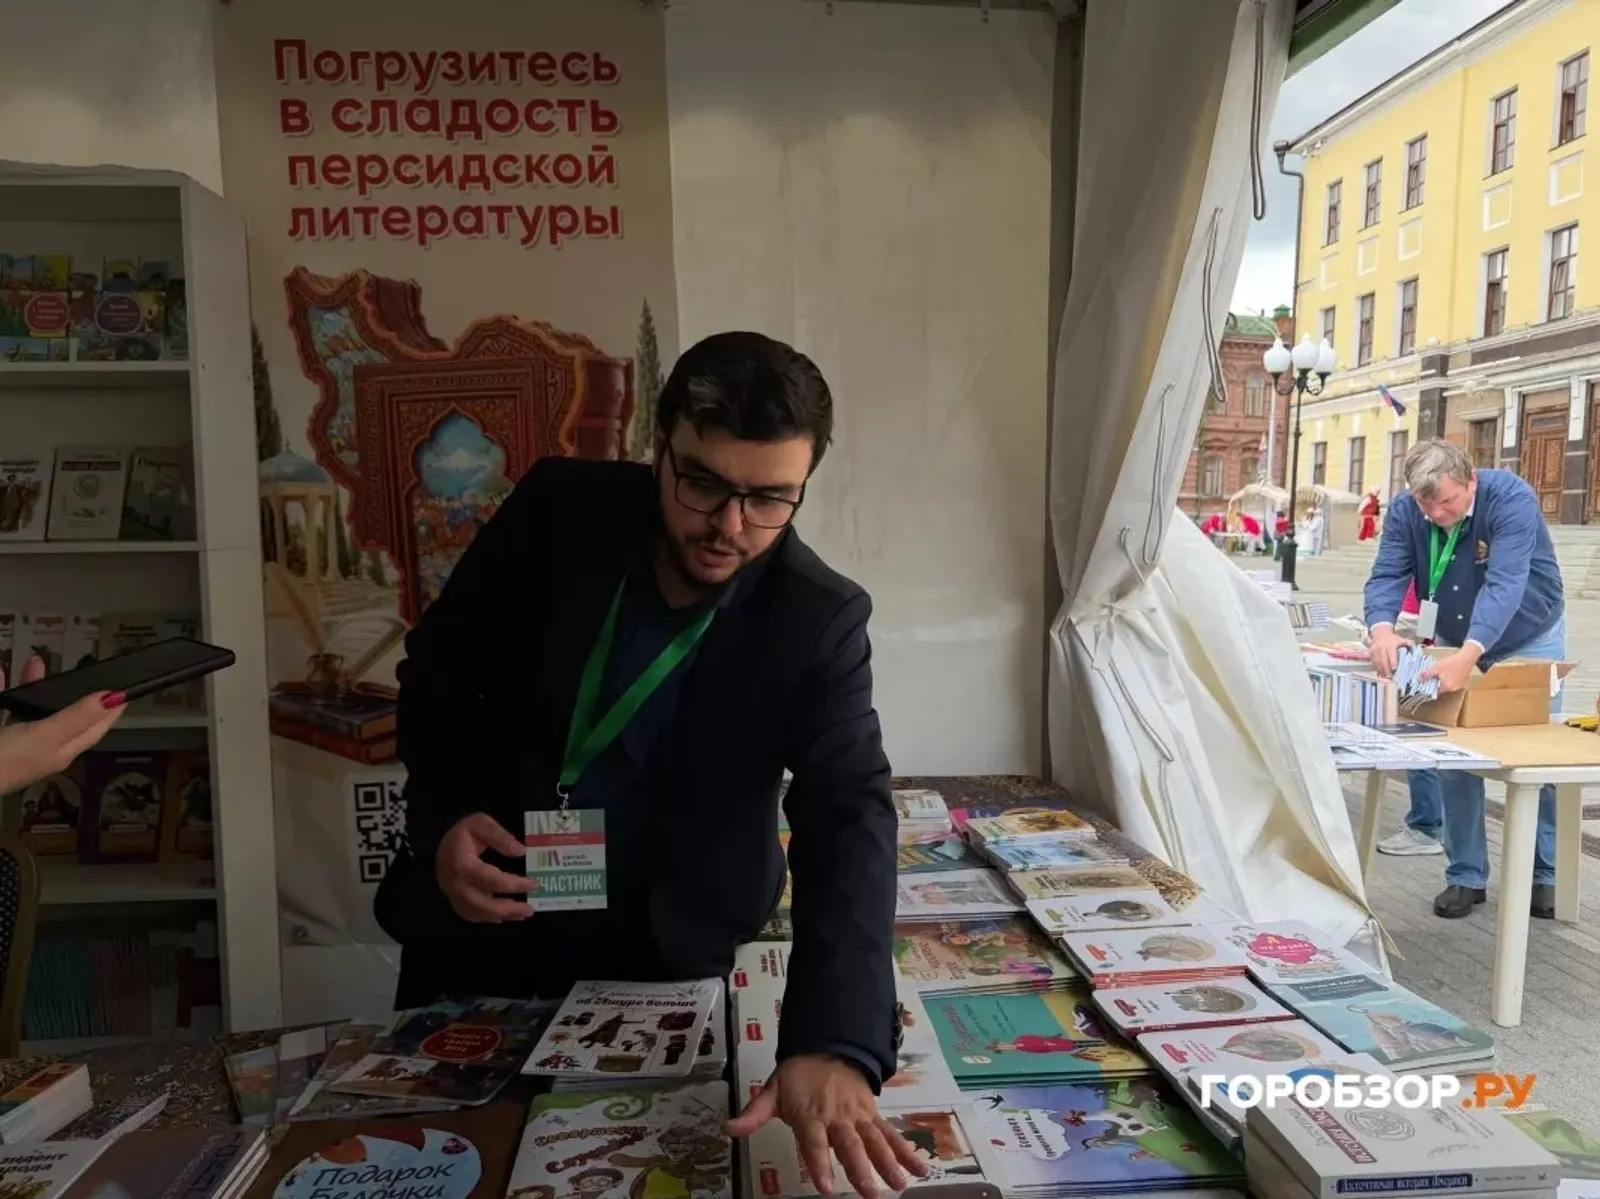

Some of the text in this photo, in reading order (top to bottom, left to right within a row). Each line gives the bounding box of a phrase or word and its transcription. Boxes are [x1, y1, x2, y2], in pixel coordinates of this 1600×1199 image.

[274, 39, 619, 93] Погрузитесь
[280, 98, 620, 142] в сладость
[288, 145, 616, 197] персидской
[288, 203, 622, 247] литературы
[534, 874, 602, 892] ЧАСТНИК
[312, 1163, 456, 1188] Подарок
